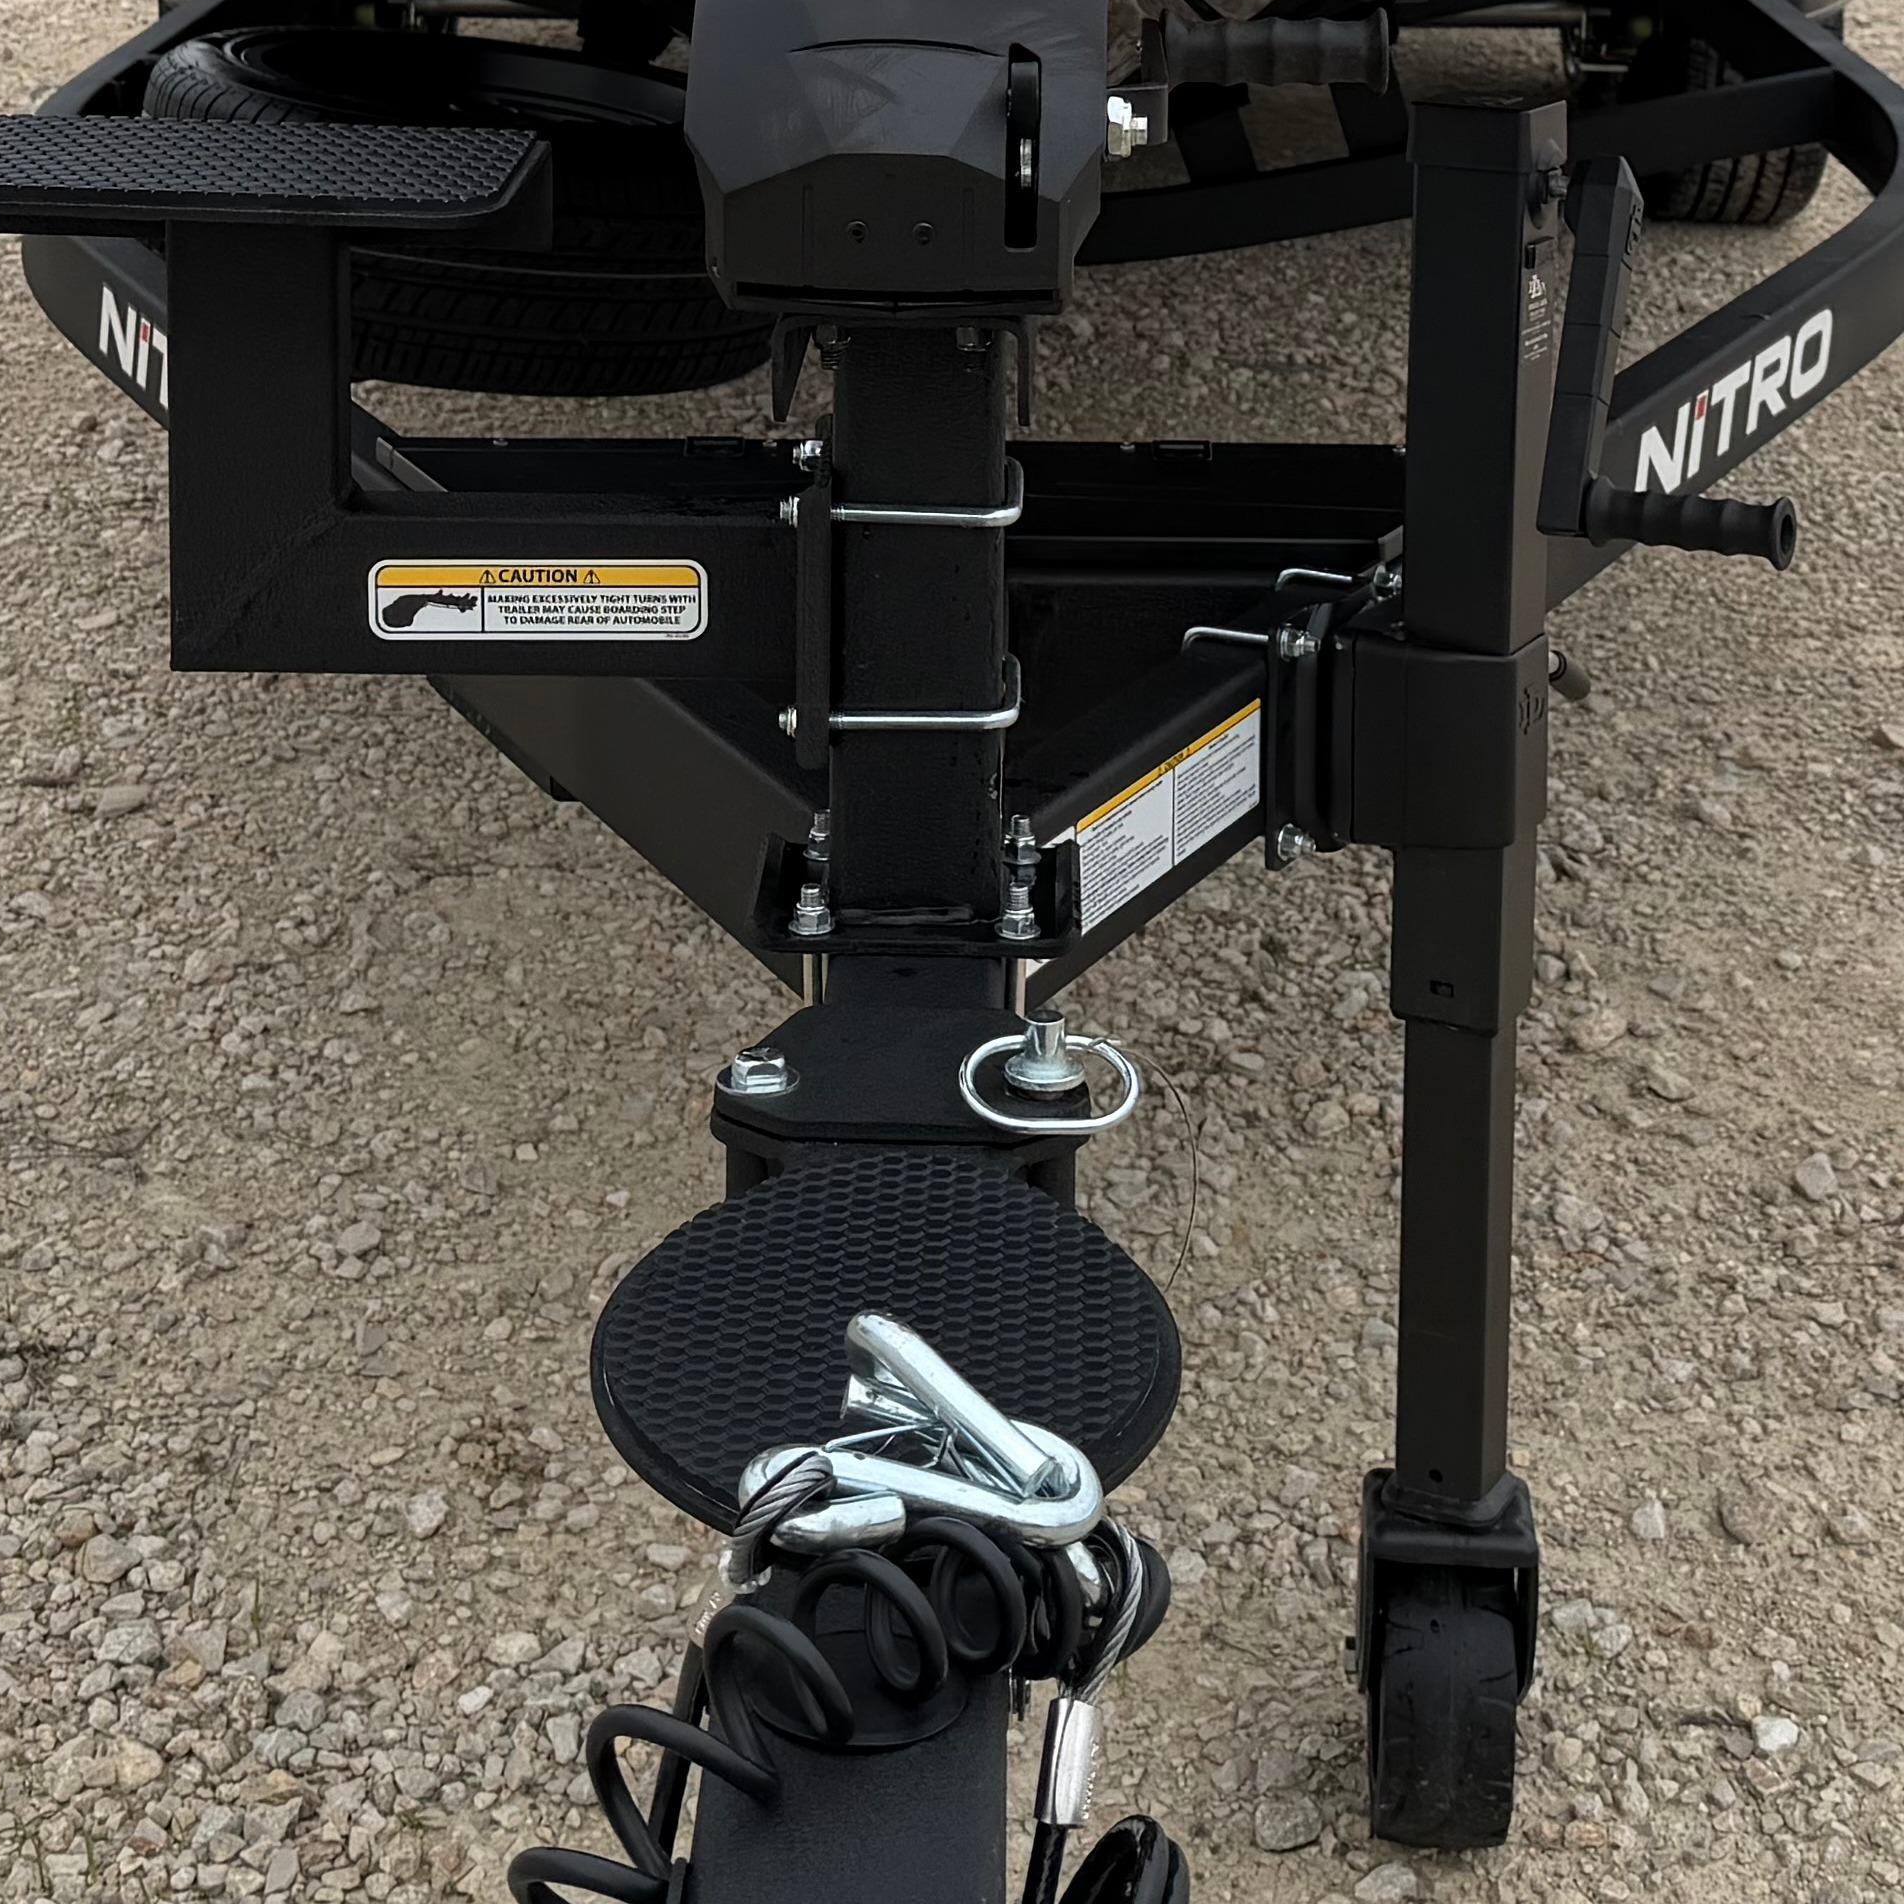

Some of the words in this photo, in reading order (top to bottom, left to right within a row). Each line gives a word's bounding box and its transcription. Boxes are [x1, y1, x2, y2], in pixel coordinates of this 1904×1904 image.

[498, 569, 578, 583] CAUTION
[487, 595, 530, 603] MAKING
[532, 595, 597, 604] EXCESSIVELY
[600, 595, 630, 604] TIGHT
[633, 595, 667, 604] TURNS
[669, 595, 696, 604] WITH
[498, 605, 540, 614] TRAILER
[542, 605, 565, 614] MAY
[567, 605, 601, 614] CAUSE
[603, 605, 658, 614] BOARDING
[660, 605, 686, 614] STEP
[504, 616, 518, 625] TO
[520, 616, 565, 625] DAMAGE
[567, 616, 594, 625] REAR
[596, 616, 610, 625] OF
[612, 616, 681, 625] AUTOMOBILE
